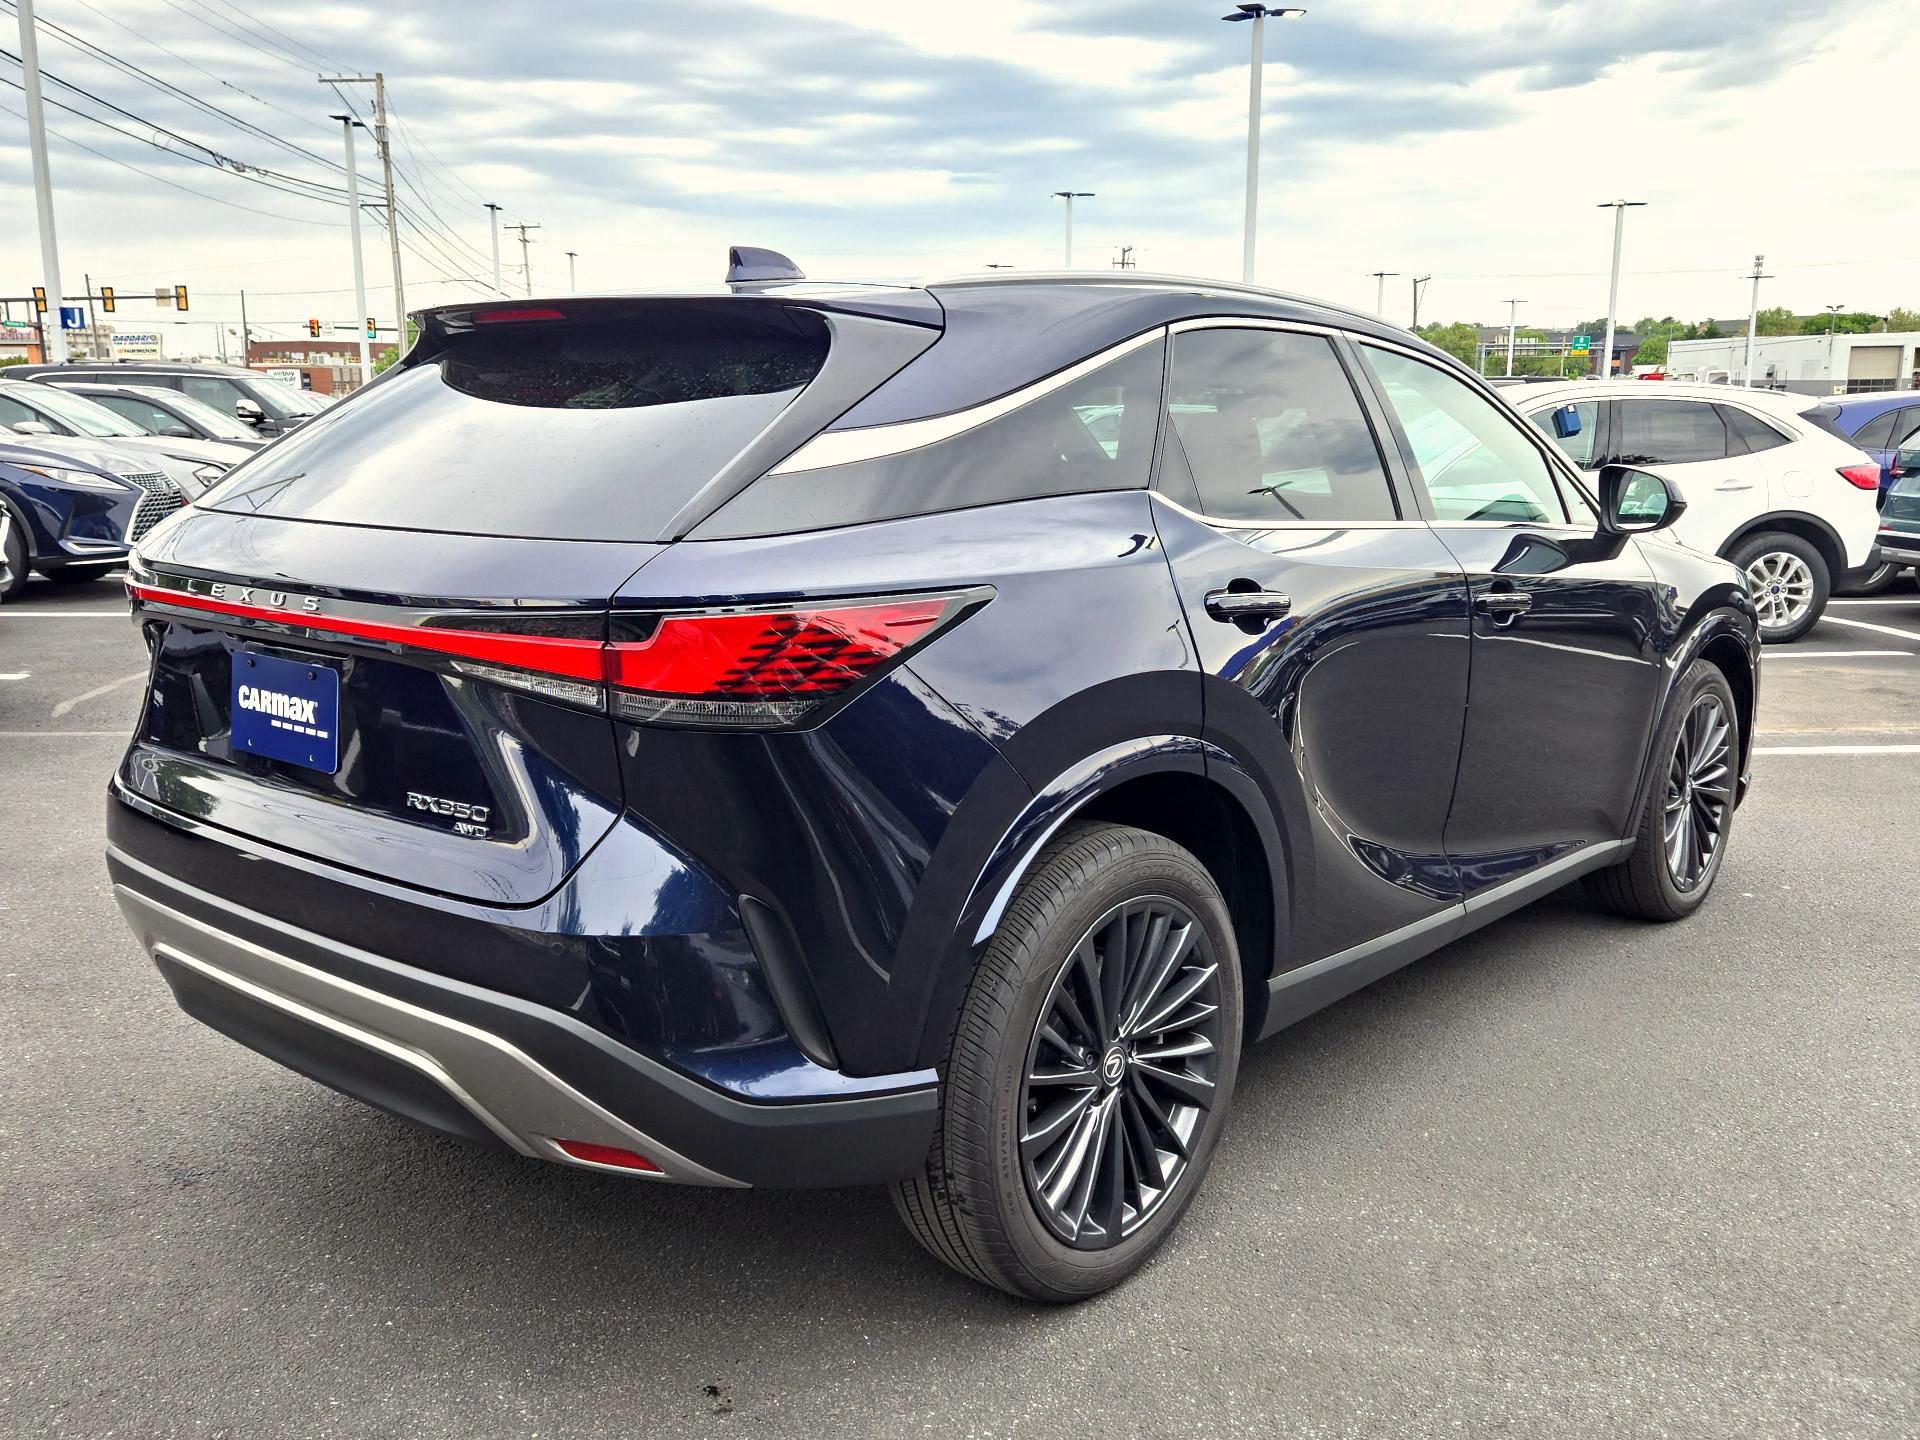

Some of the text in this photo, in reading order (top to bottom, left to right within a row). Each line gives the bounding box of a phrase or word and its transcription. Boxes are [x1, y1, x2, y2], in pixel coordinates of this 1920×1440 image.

[66, 308, 81, 328] J
[187, 580, 322, 612] LEXUS
[451, 821, 490, 838] AWD
